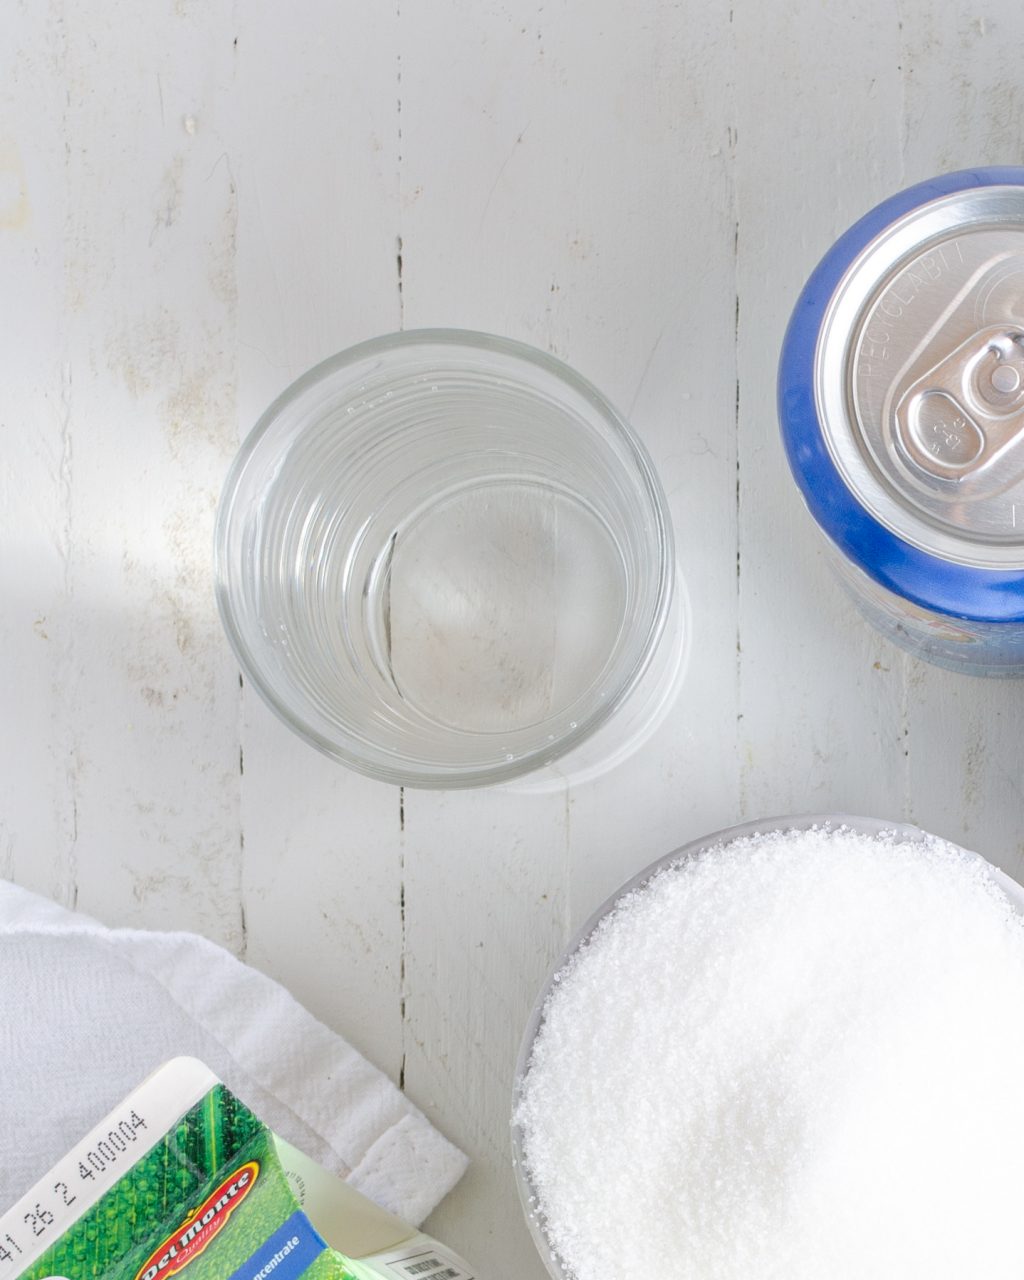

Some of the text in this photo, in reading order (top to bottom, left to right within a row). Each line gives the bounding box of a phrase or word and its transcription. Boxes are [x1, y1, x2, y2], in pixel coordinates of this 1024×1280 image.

[24, 1203, 55, 1237] 26
[54, 1182, 77, 1206] 2
[78, 1110, 148, 1181] 400004
[180, 1169, 250, 1247] Monte
